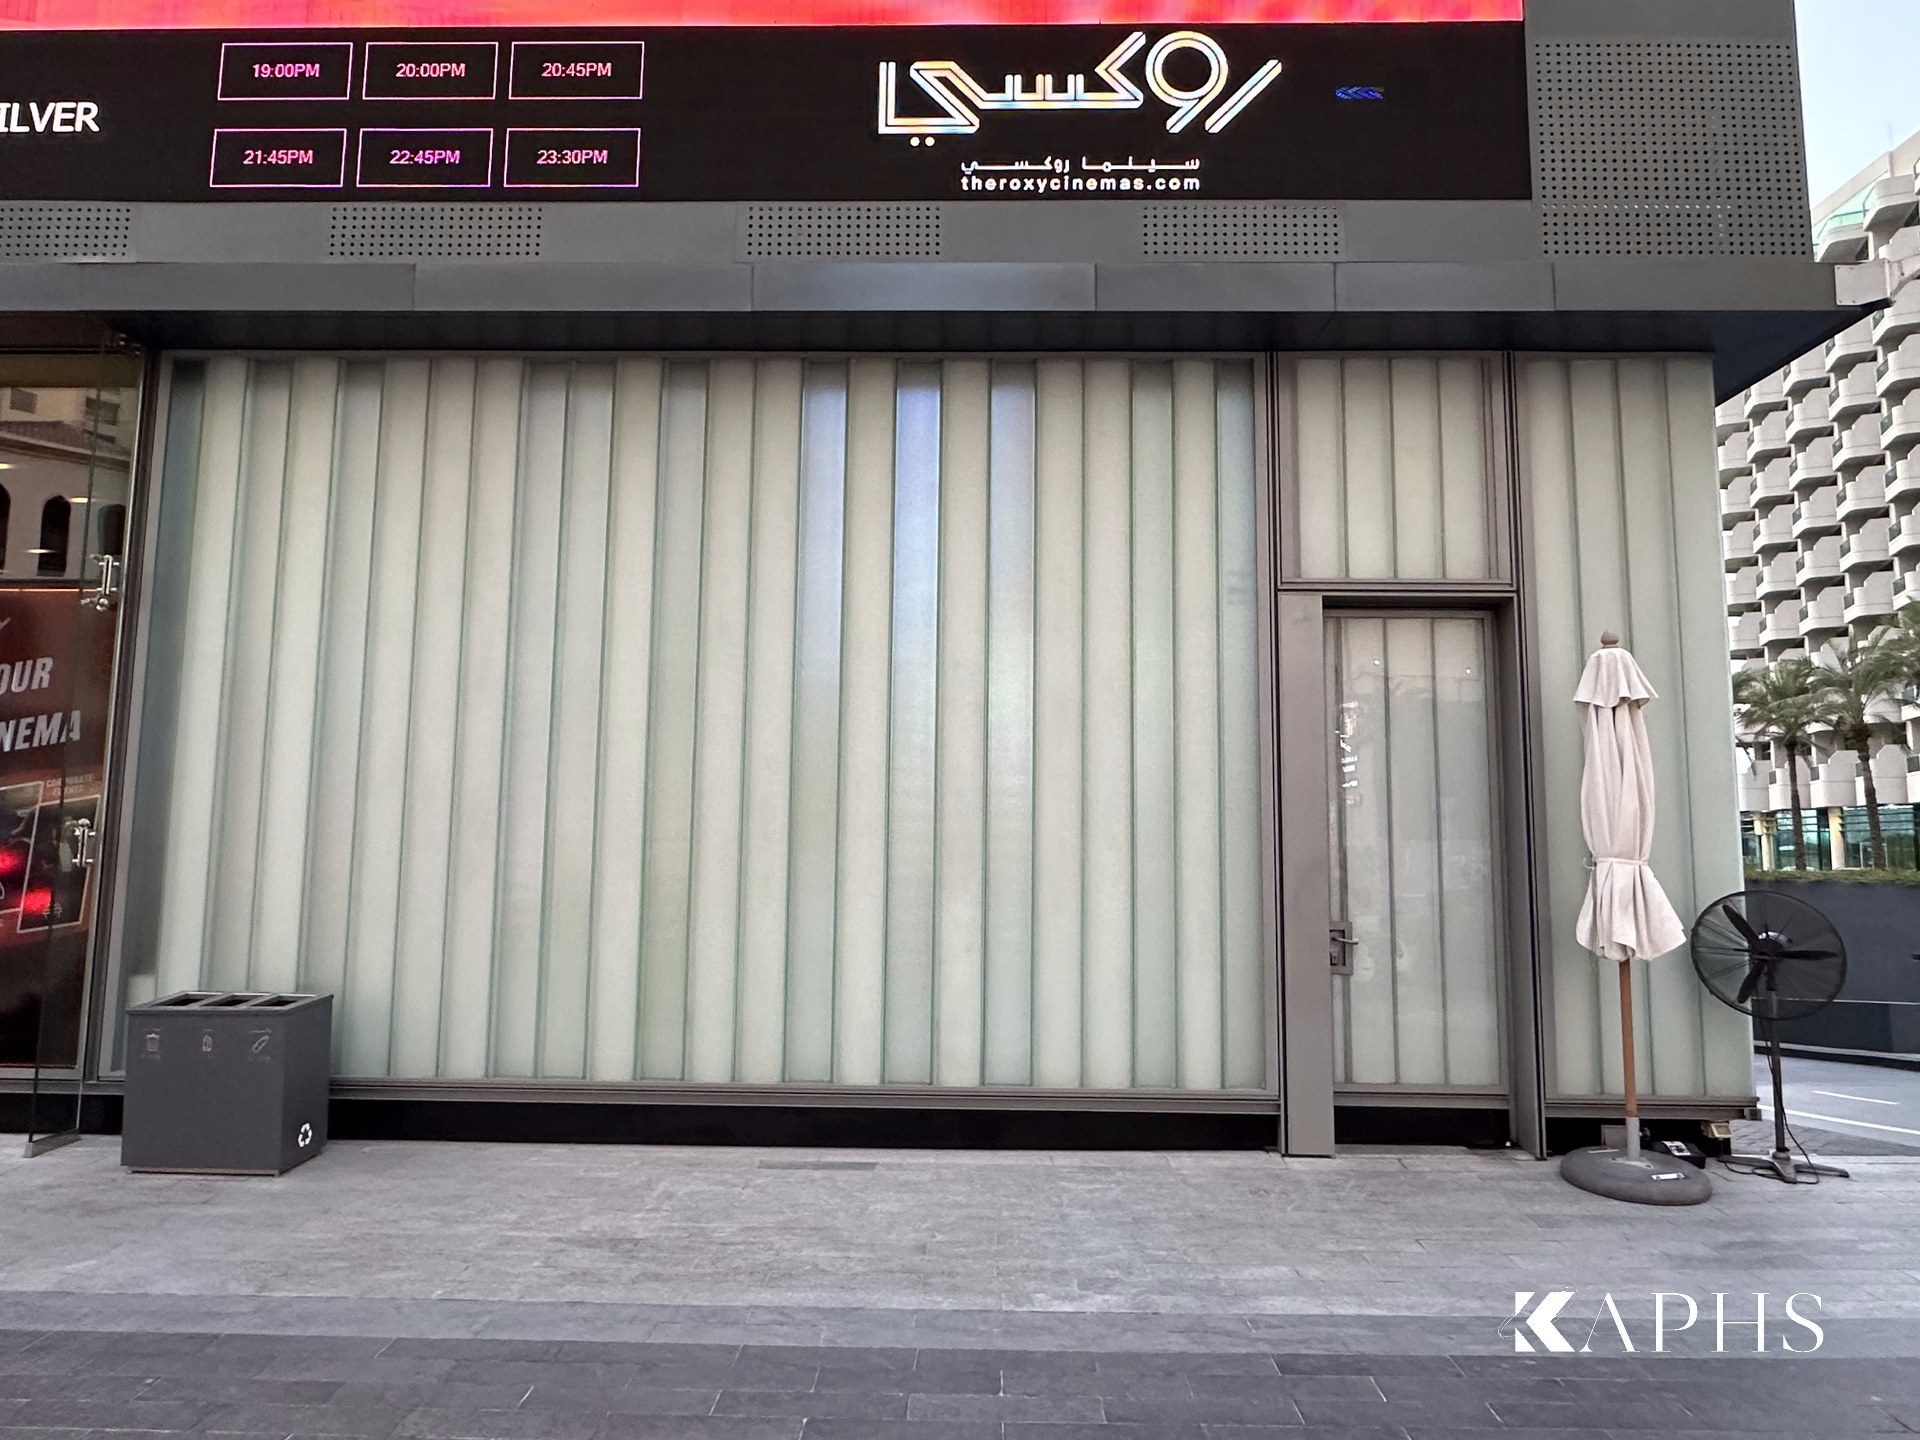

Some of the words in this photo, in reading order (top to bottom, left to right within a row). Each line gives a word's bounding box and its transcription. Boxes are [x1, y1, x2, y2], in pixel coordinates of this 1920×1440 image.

[252, 63, 321, 78] 19:00PM
[395, 62, 466, 78] 20:00PM
[541, 62, 612, 77] 20:45PM
[0, 101, 100, 133] ILVER
[242, 149, 314, 165] 21:45PM
[389, 149, 461, 165] 22:45PM
[536, 149, 609, 165] 23:30PM
[960, 155, 1070, 175] روكسي
[1082, 155, 1200, 173] سينما
[960, 175, 1200, 194] theroxycinemas.com
